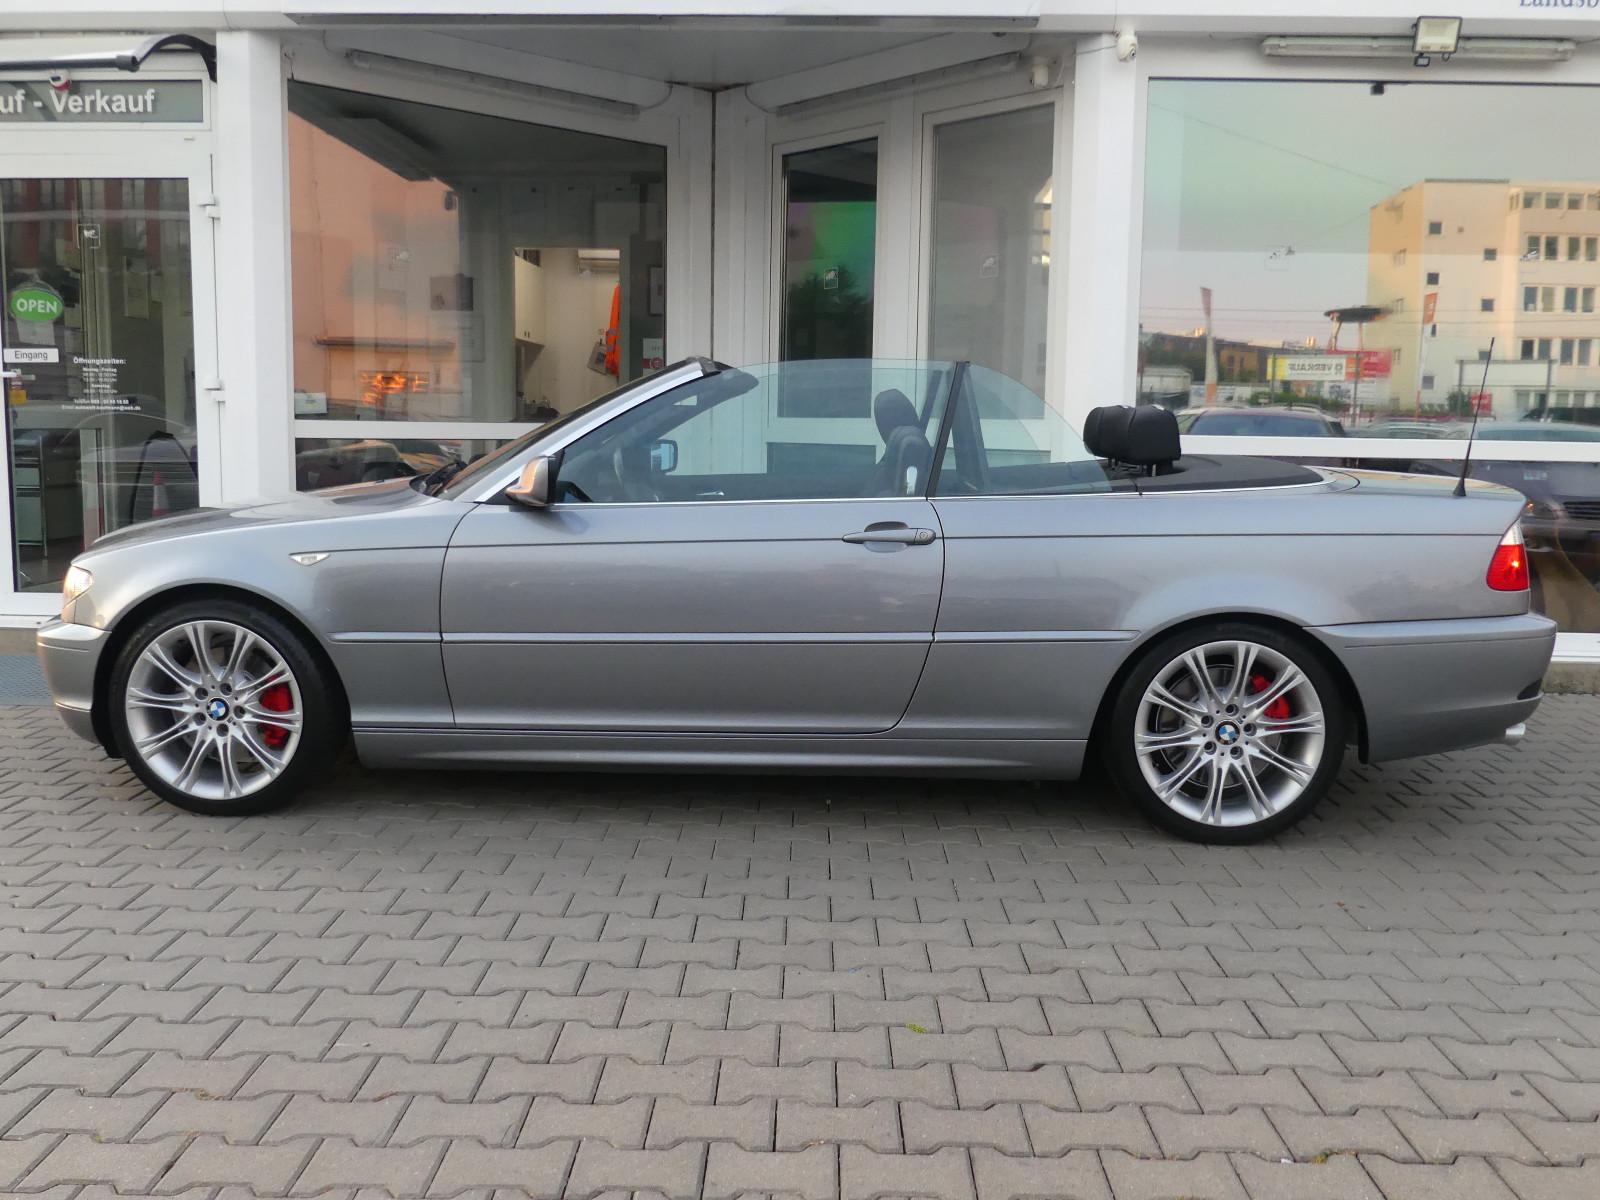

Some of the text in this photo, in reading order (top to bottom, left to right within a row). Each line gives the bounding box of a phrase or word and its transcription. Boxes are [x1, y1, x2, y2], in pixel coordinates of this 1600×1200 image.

[50, 89, 155, 113] Verkauf
[16, 298, 58, 314] OPEN
[14, 351, 48, 360] Eingang
